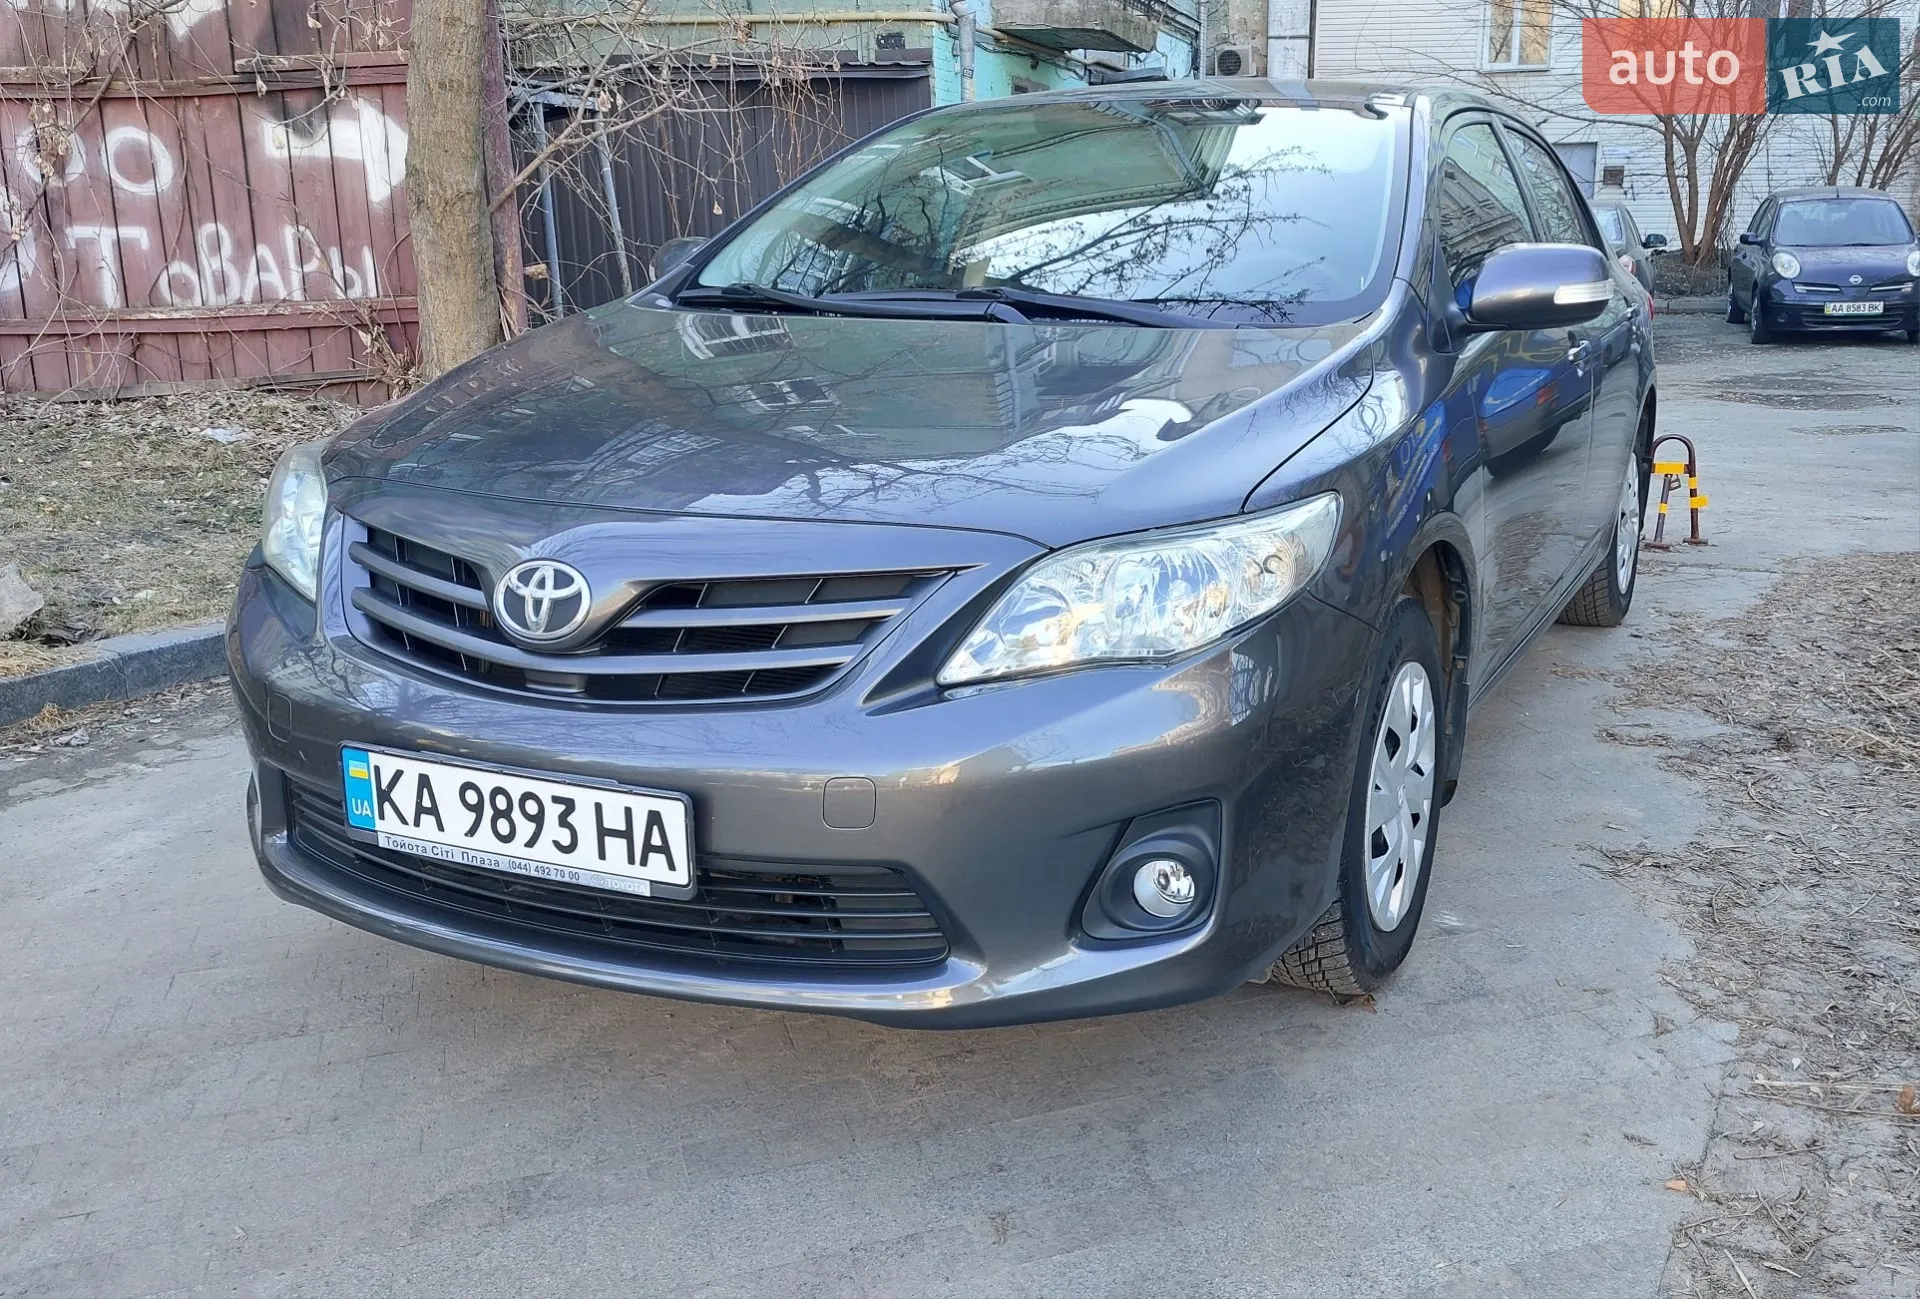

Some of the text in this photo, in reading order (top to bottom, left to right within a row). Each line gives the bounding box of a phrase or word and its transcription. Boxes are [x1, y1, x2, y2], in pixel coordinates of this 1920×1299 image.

[351, 797, 373, 818] UA
[373, 764, 677, 872] KA 9893 HA
[384, 835, 580, 882] Тойота Сіті Плаза (044) 492 70 00
